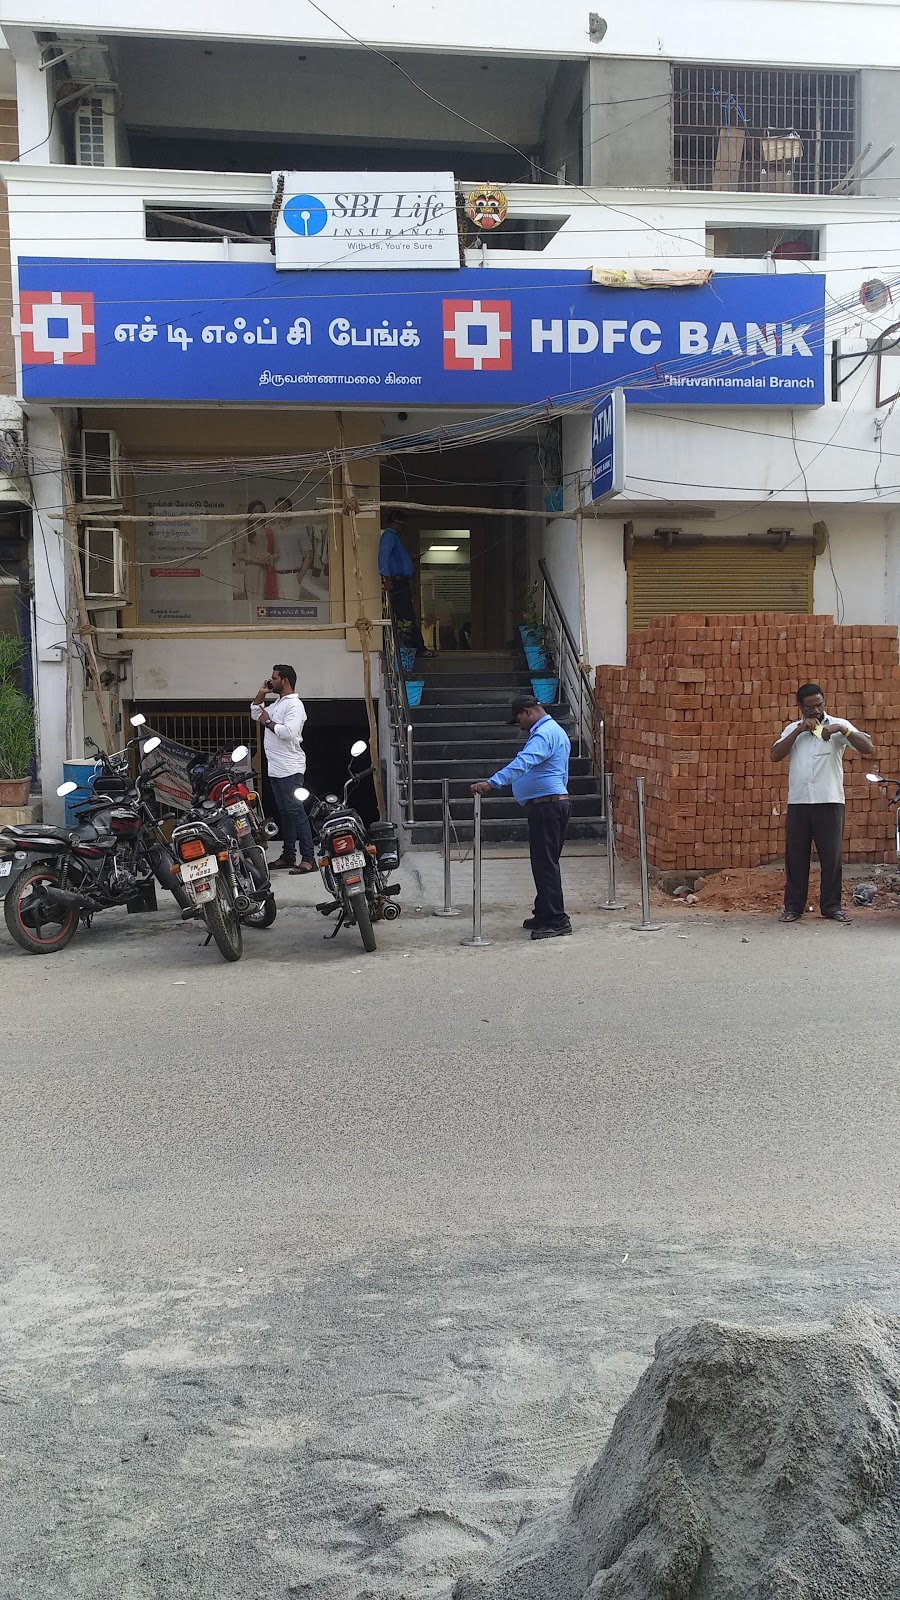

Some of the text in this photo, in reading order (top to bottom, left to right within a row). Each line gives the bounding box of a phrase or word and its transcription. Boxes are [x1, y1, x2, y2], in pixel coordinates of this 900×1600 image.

[332, 194, 444, 226] SBI Life
[333, 228, 446, 237] INSURANCE
[347, 242, 433, 251] With Us, You're Sure
[114, 315, 421, 351] எச் டி எஃப் சி பேங்க்
[530, 318, 814, 358] HDFC BANK
[258, 370, 422, 387] திருவண்ணாமலை கிளை
[769, 375, 814, 388] Branch
[593, 404, 612, 448] ATM
[351, 853, 361, 862] 25
